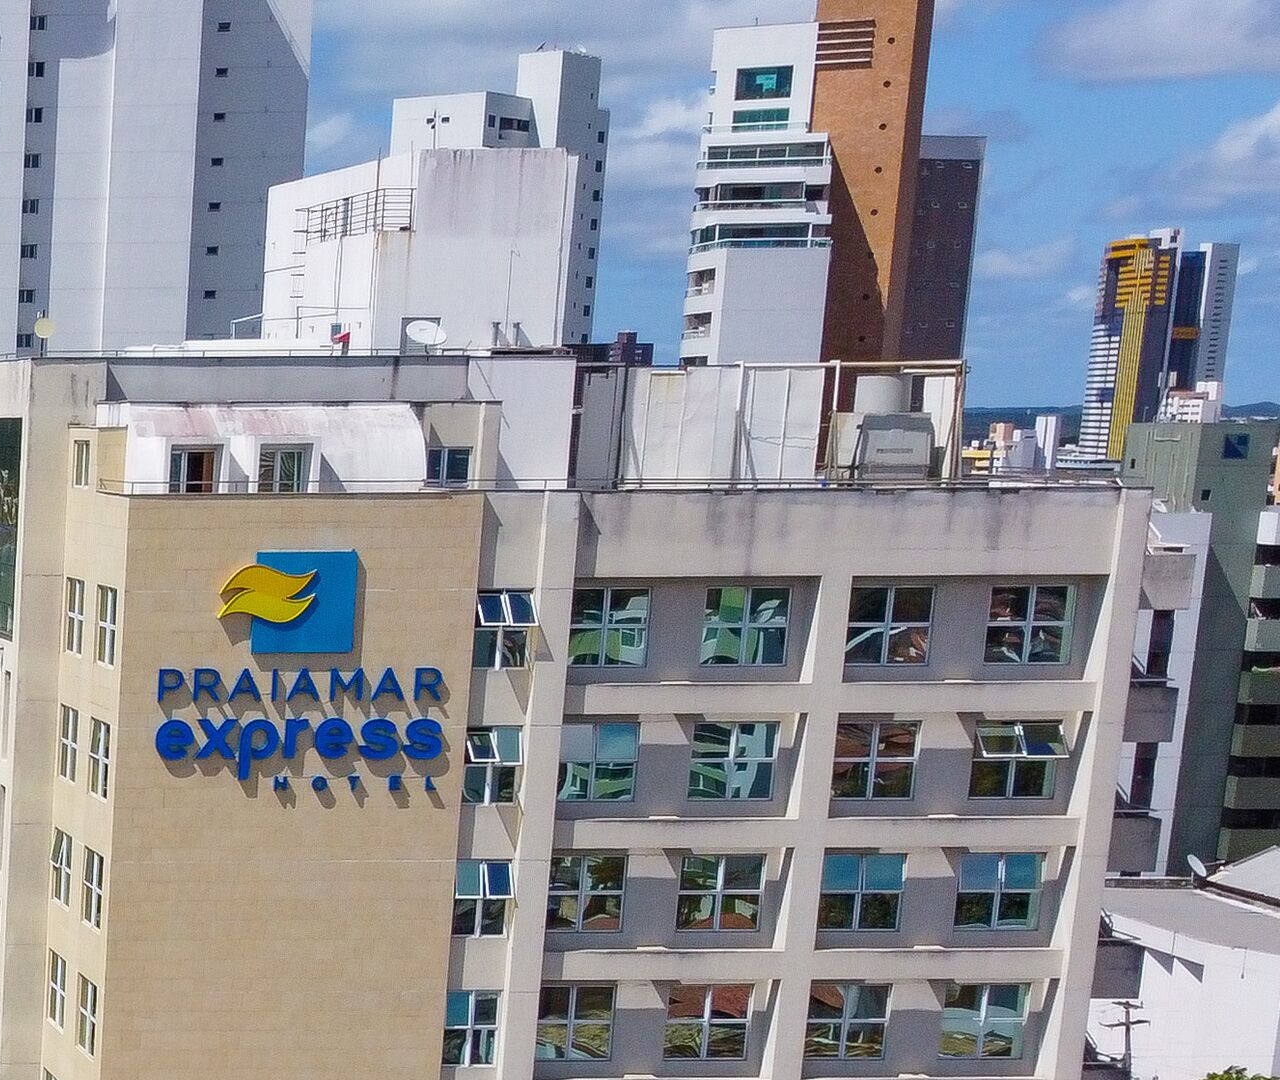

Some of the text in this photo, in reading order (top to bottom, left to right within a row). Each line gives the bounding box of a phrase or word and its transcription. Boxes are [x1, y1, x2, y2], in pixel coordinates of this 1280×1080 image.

[157, 667, 444, 702] PRAIAMAR
[154, 716, 444, 781] express
[273, 775, 437, 792] HOTEL
